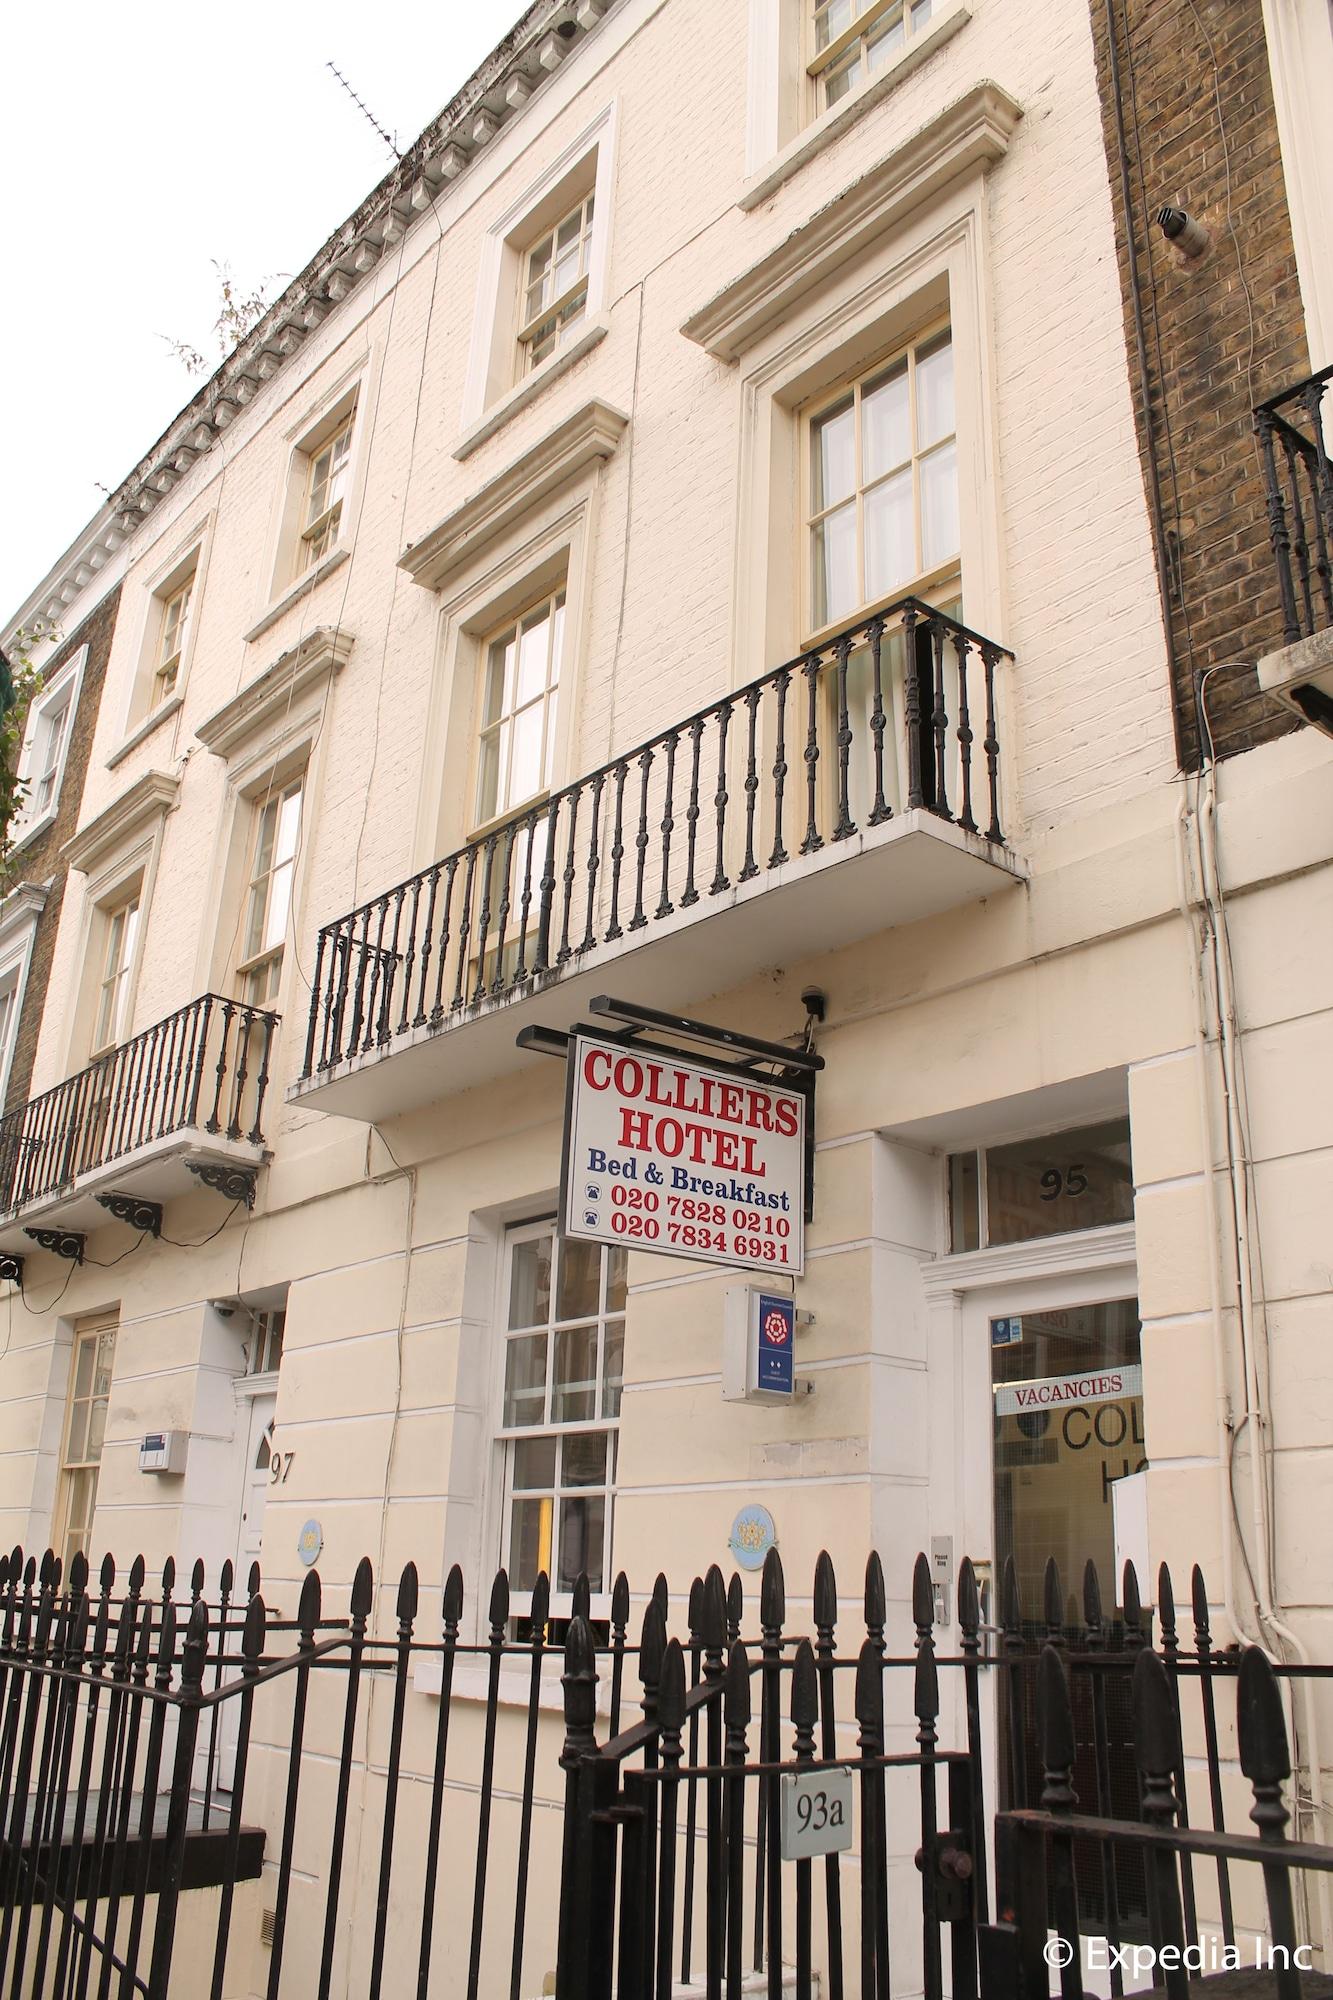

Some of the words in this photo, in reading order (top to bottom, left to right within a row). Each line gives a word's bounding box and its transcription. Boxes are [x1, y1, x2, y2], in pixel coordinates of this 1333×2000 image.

[584, 1049, 798, 1136] COLLIERS
[617, 1107, 766, 1177] HOTEL
[587, 1148, 637, 1180] Bed
[644, 1162, 664, 1185] &
[670, 1166, 790, 1212] Breakfast
[1039, 1164, 1088, 1202] 95
[611, 1185, 659, 1212] 020
[667, 1195, 726, 1226] 7828
[732, 1209, 790, 1238] 0210
[611, 1212, 660, 1239] 020
[667, 1222, 727, 1252] 7834
[733, 1237, 789, 1263] 6931
[1014, 1375, 1123, 1406] VACANCIES
[271, 1452, 295, 1485] 97
[797, 1791, 845, 1834] 93a
